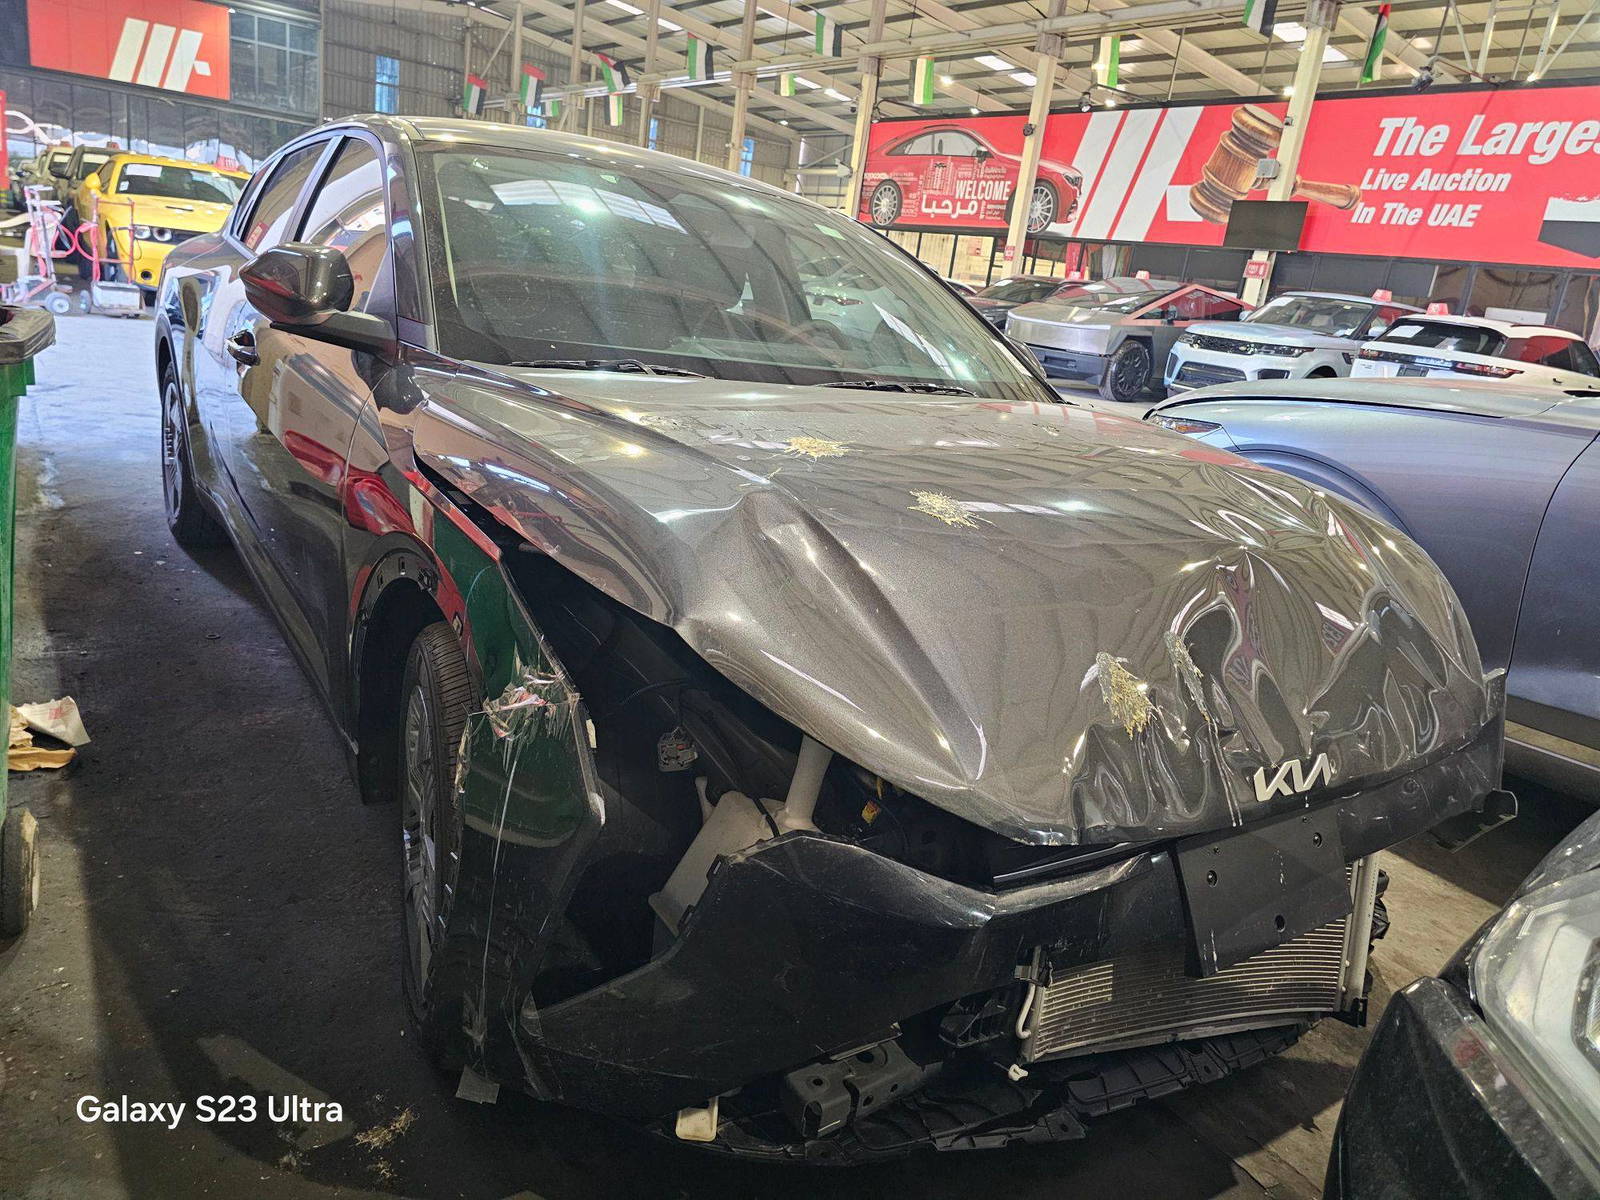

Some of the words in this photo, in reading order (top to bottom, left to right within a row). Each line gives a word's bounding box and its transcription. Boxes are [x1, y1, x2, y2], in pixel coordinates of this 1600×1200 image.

[1372, 116, 1450, 157] The
[955, 179, 1012, 201] WELCOME
[1360, 168, 1410, 191] Live
[1410, 168, 1512, 192] Auction
[921, 193, 979, 219] مرحبا
[1351, 201, 1376, 224] In
[1380, 202, 1423, 226] The
[1427, 203, 1483, 228] UAE
[1253, 752, 1332, 802] KIA
